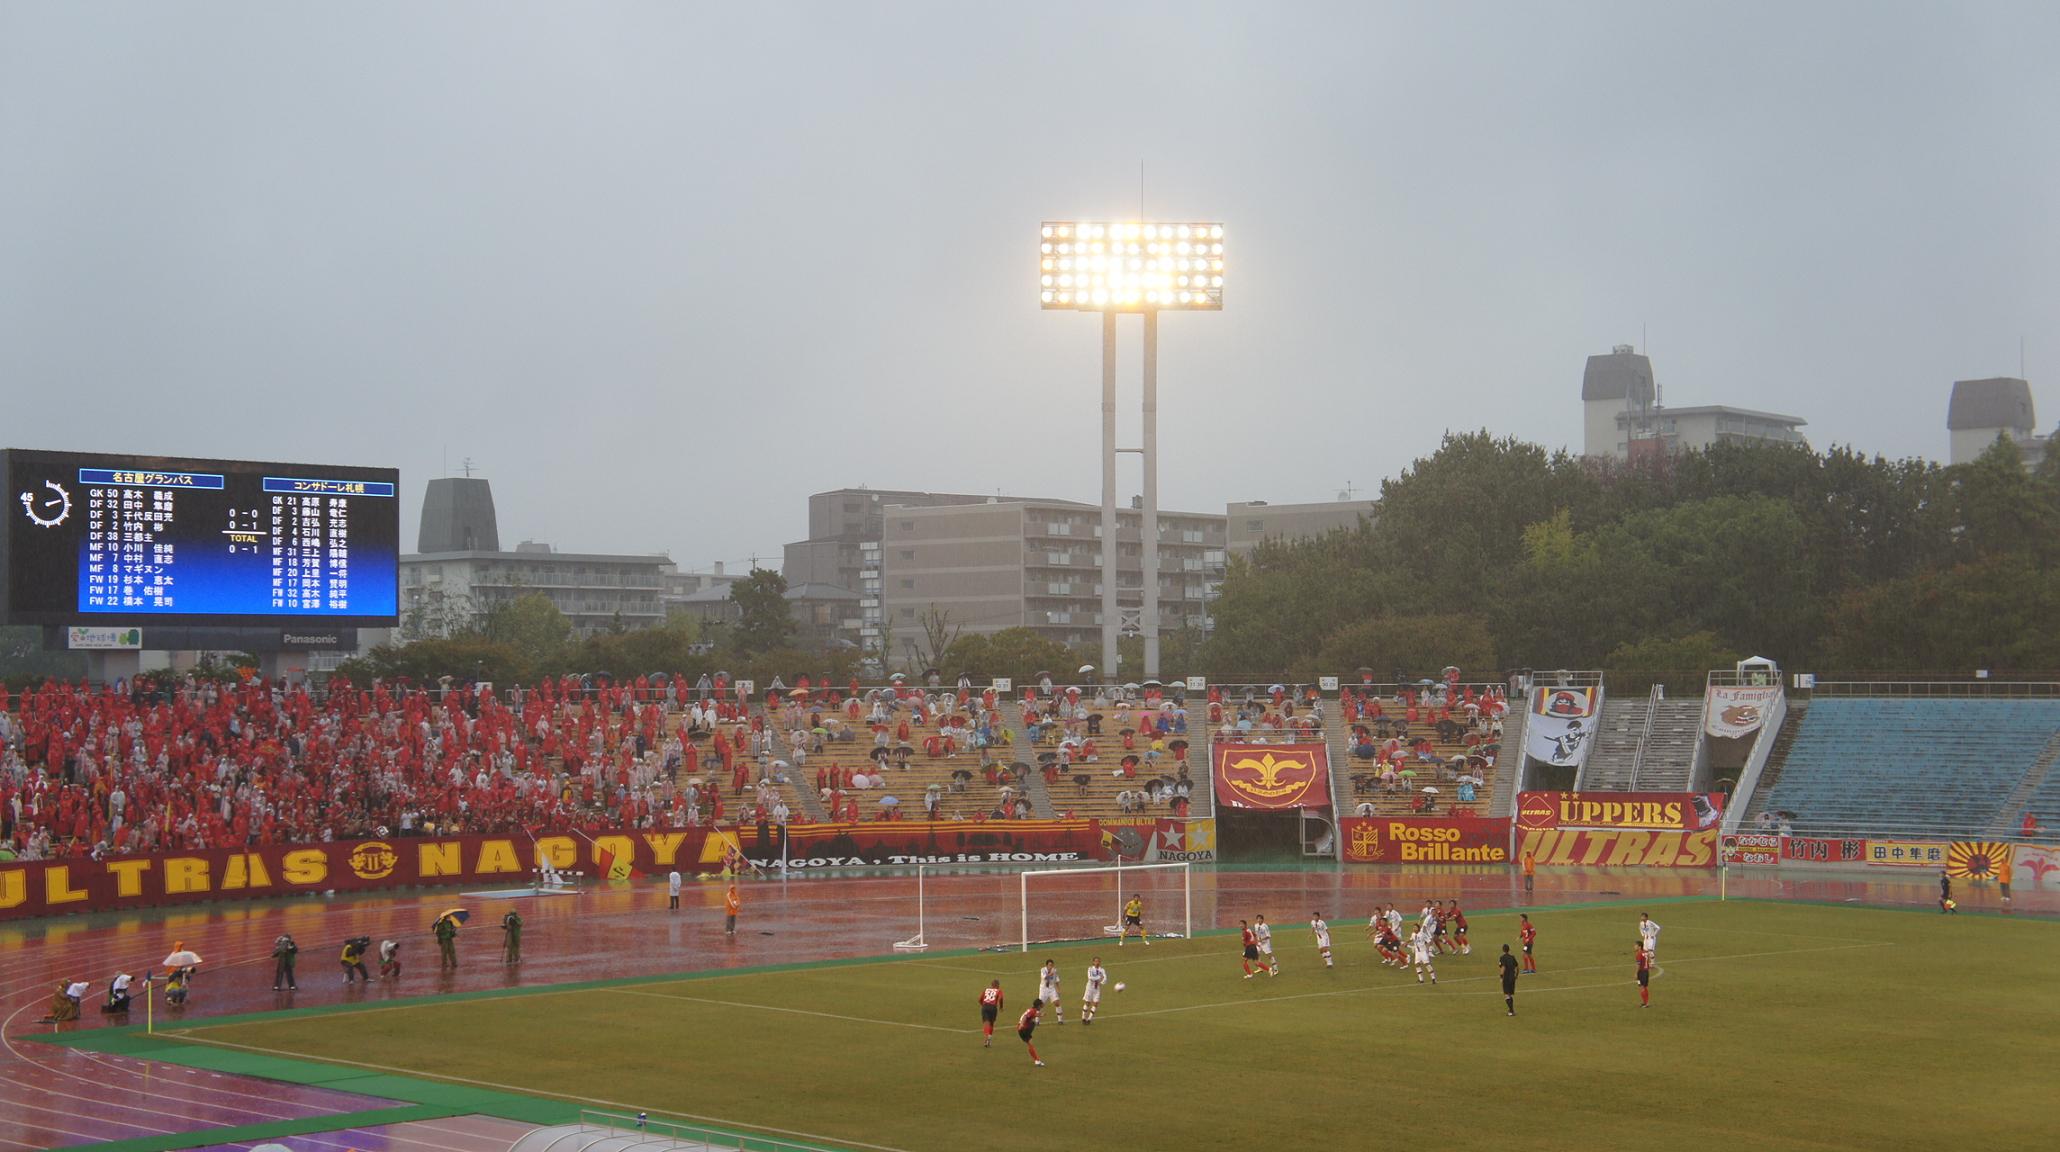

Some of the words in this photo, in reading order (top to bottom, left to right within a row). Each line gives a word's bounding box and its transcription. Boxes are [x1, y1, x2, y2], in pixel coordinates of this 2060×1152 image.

[294, 482, 365, 494] コンサドーレ札幌
[20, 491, 34, 502] 45
[90, 489, 103, 497] GK
[107, 489, 118, 497] 50
[107, 500, 118, 508] 32
[124, 501, 143, 510] 田中
[273, 496, 283, 504] GK
[287, 497, 296, 505] 21
[90, 510, 103, 518] DF
[113, 511, 118, 519] 3
[229, 509, 235, 517] 0
[252, 510, 258, 518] 0
[273, 506, 283, 514] DF
[292, 507, 297, 515] 3
[230, 521, 235, 529] 0
[292, 517, 297, 525] 2
[90, 521, 103, 529] DF
[113, 521, 118, 530] 2
[124, 521, 143, 531] 竹内
[90, 532, 103, 540] DF
[108, 532, 118, 540] 38
[273, 527, 282, 535] DF
[302, 528, 320, 537] 石川
[230, 534, 258, 543] TOTAL
[273, 537, 283, 545] DF
[293, 538, 297, 546] 6
[108, 543, 118, 551] 10
[124, 543, 143, 552] 小川
[229, 545, 235, 553] 0
[273, 547, 283, 555] MF
[288, 548, 296, 556] 31
[302, 549, 320, 557] 三上
[113, 553, 118, 561] 7
[124, 554, 143, 563] 中村
[273, 558, 283, 566] MF
[289, 558, 297, 566] 18
[113, 564, 118, 573] 8
[273, 568, 282, 576] MF
[288, 568, 297, 576] 20
[90, 575, 103, 583] FW
[108, 575, 118, 583] 19
[124, 575, 143, 584] 杉本
[273, 578, 282, 586] MF
[289, 578, 297, 586] 17
[302, 579, 320, 588] 岡本
[90, 586, 103, 594] FW
[108, 586, 118, 594] 17
[273, 588, 283, 596] FW
[288, 589, 297, 597] 32
[90, 597, 103, 605] FW
[108, 596, 118, 605] 22
[273, 599, 283, 607] FW
[289, 599, 298, 607] 10
[283, 635, 337, 645] Panasonic
[1390, 822, 1461, 842] Rosso
[1402, 842, 1505, 862] Brillante
[1518, 829, 1718, 866] ULTRAS
[1790, 838, 1834, 859] 竹内
[1160, 850, 1213, 861] NAGOYA
[749, 856, 866, 868] NAGOYA
[888, 856, 951, 864] This
[957, 854, 981, 862] is
[988, 853, 1079, 861] HOME
[0, 850, 328, 908] ULTRAS
[418, 831, 742, 877] NAGOYA
